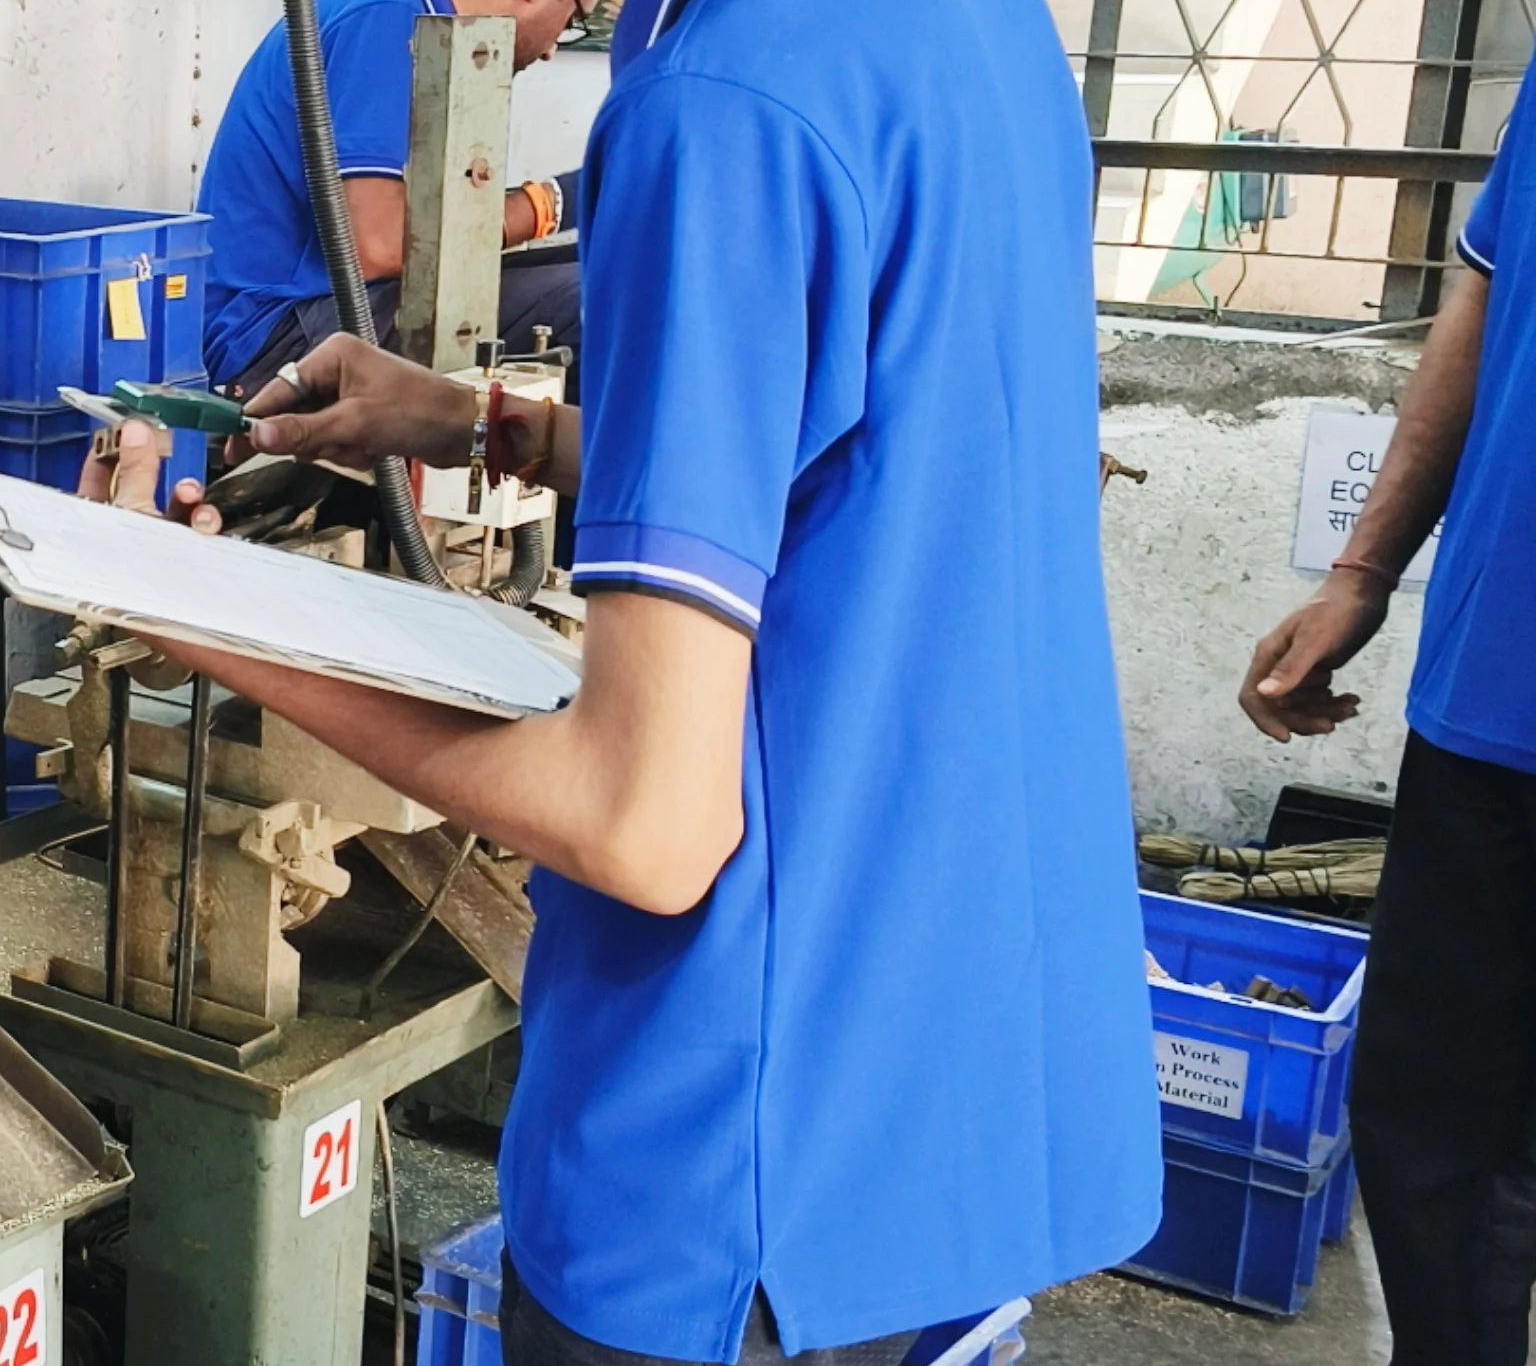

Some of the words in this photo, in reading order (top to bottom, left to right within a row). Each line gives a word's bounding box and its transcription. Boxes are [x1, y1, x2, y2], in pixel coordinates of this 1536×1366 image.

[1347, 451, 1379, 473] CL
[1331, 480, 1371, 503] EQ
[1171, 1042, 1221, 1065] Work
[1172, 1063, 1239, 1089] Process
[309, 1118, 352, 1205] 21
